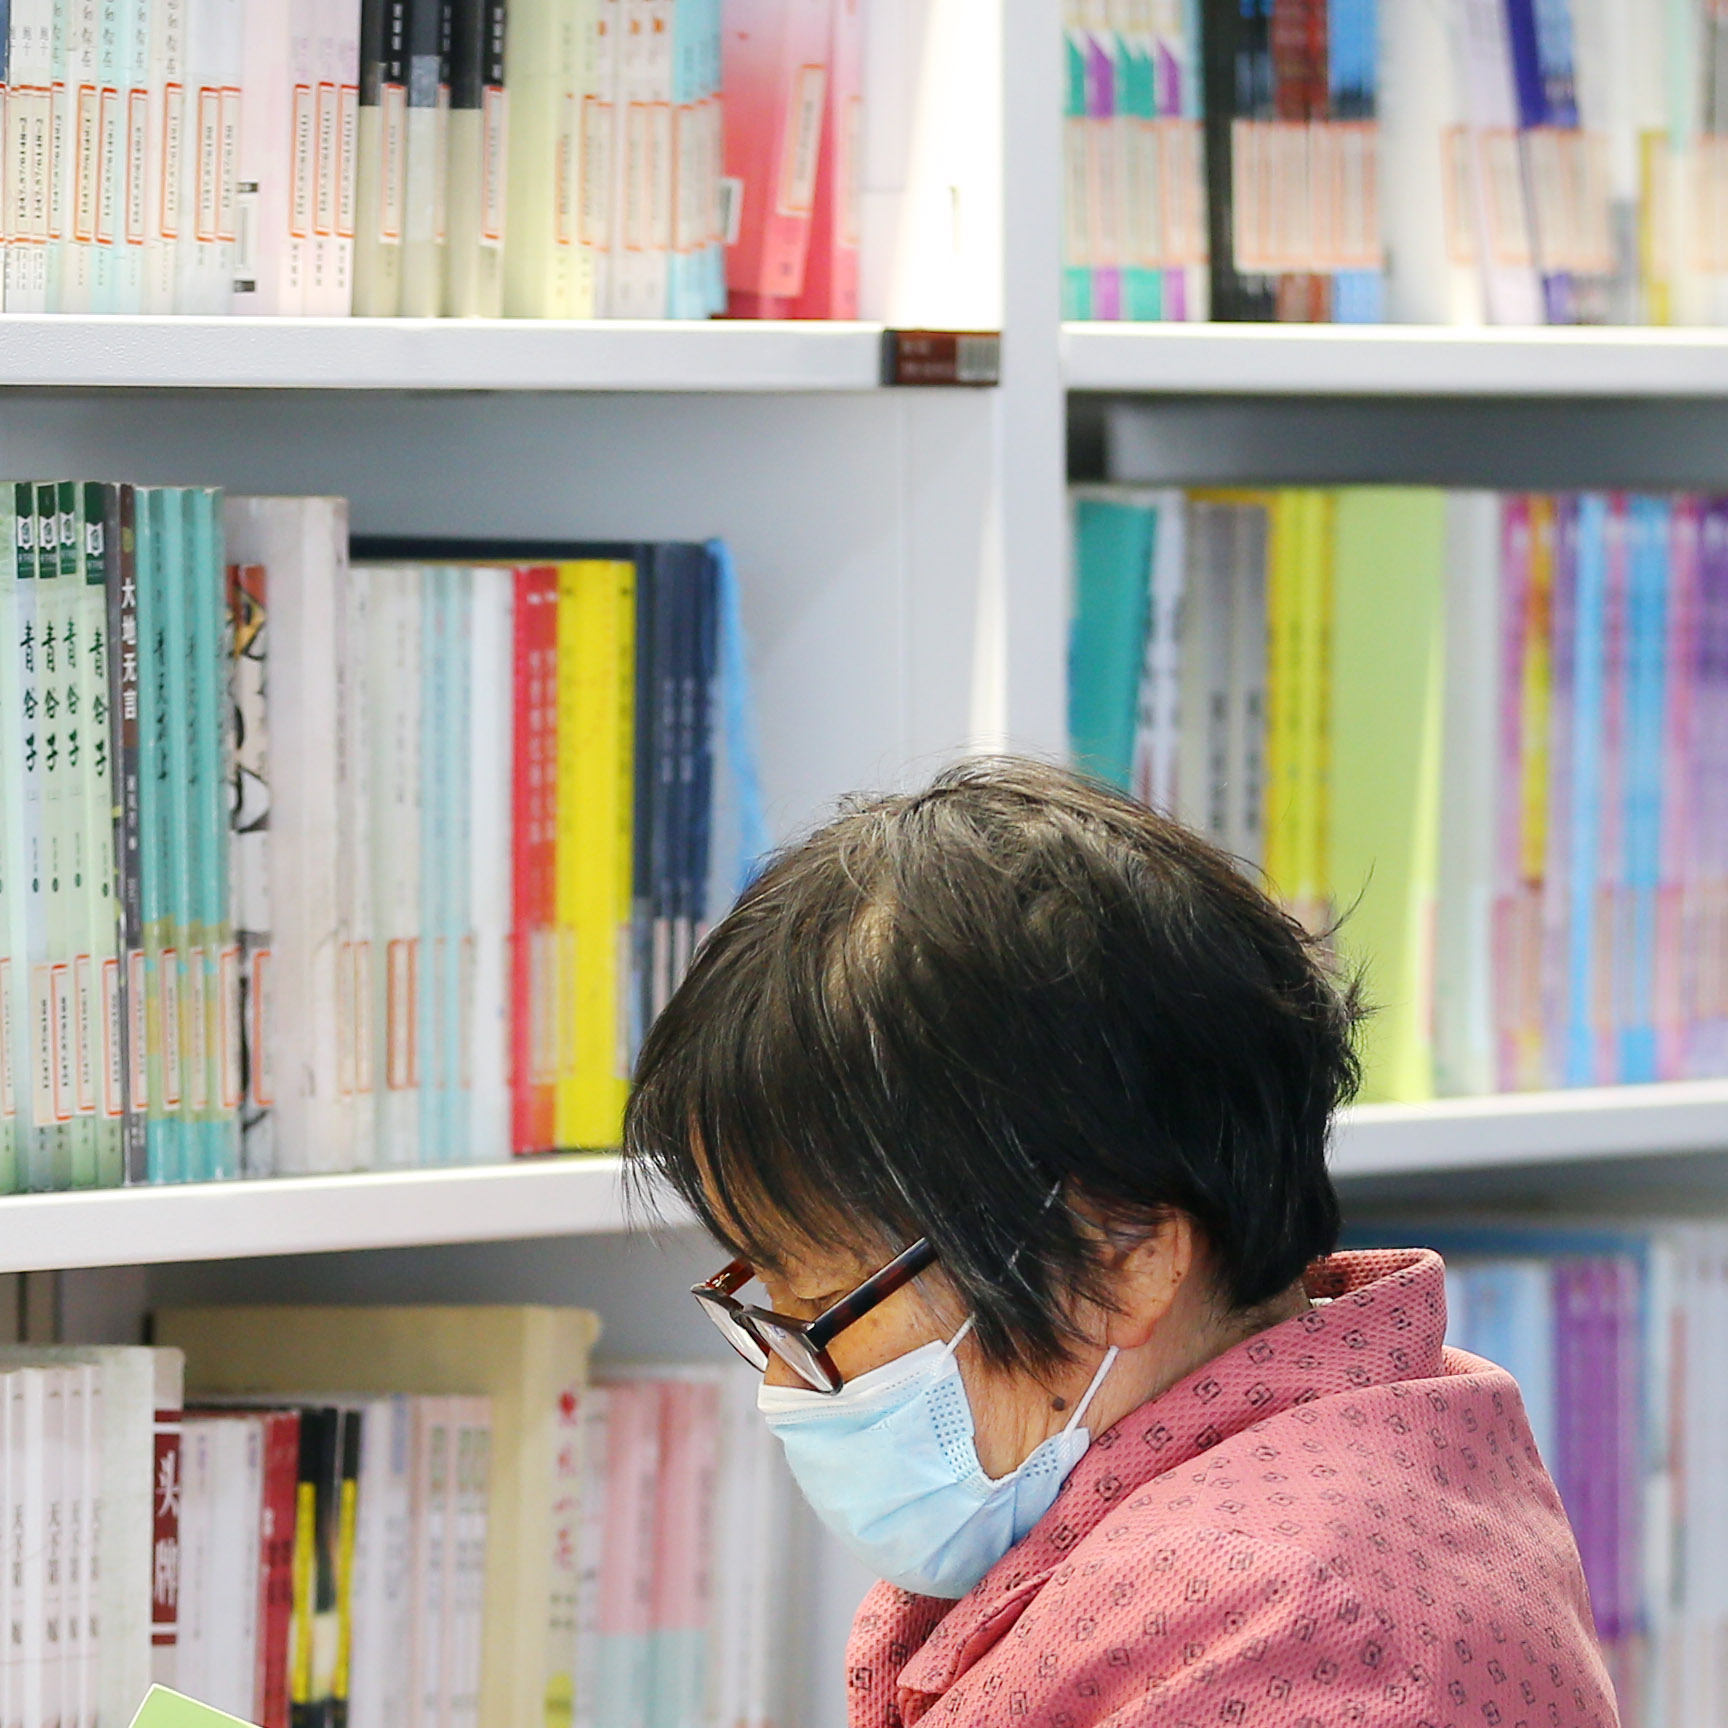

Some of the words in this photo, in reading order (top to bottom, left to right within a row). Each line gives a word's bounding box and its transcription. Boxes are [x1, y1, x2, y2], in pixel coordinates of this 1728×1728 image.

[120, 577, 138, 721] 大地无言
[157, 1449, 181, 1607] 头牌
